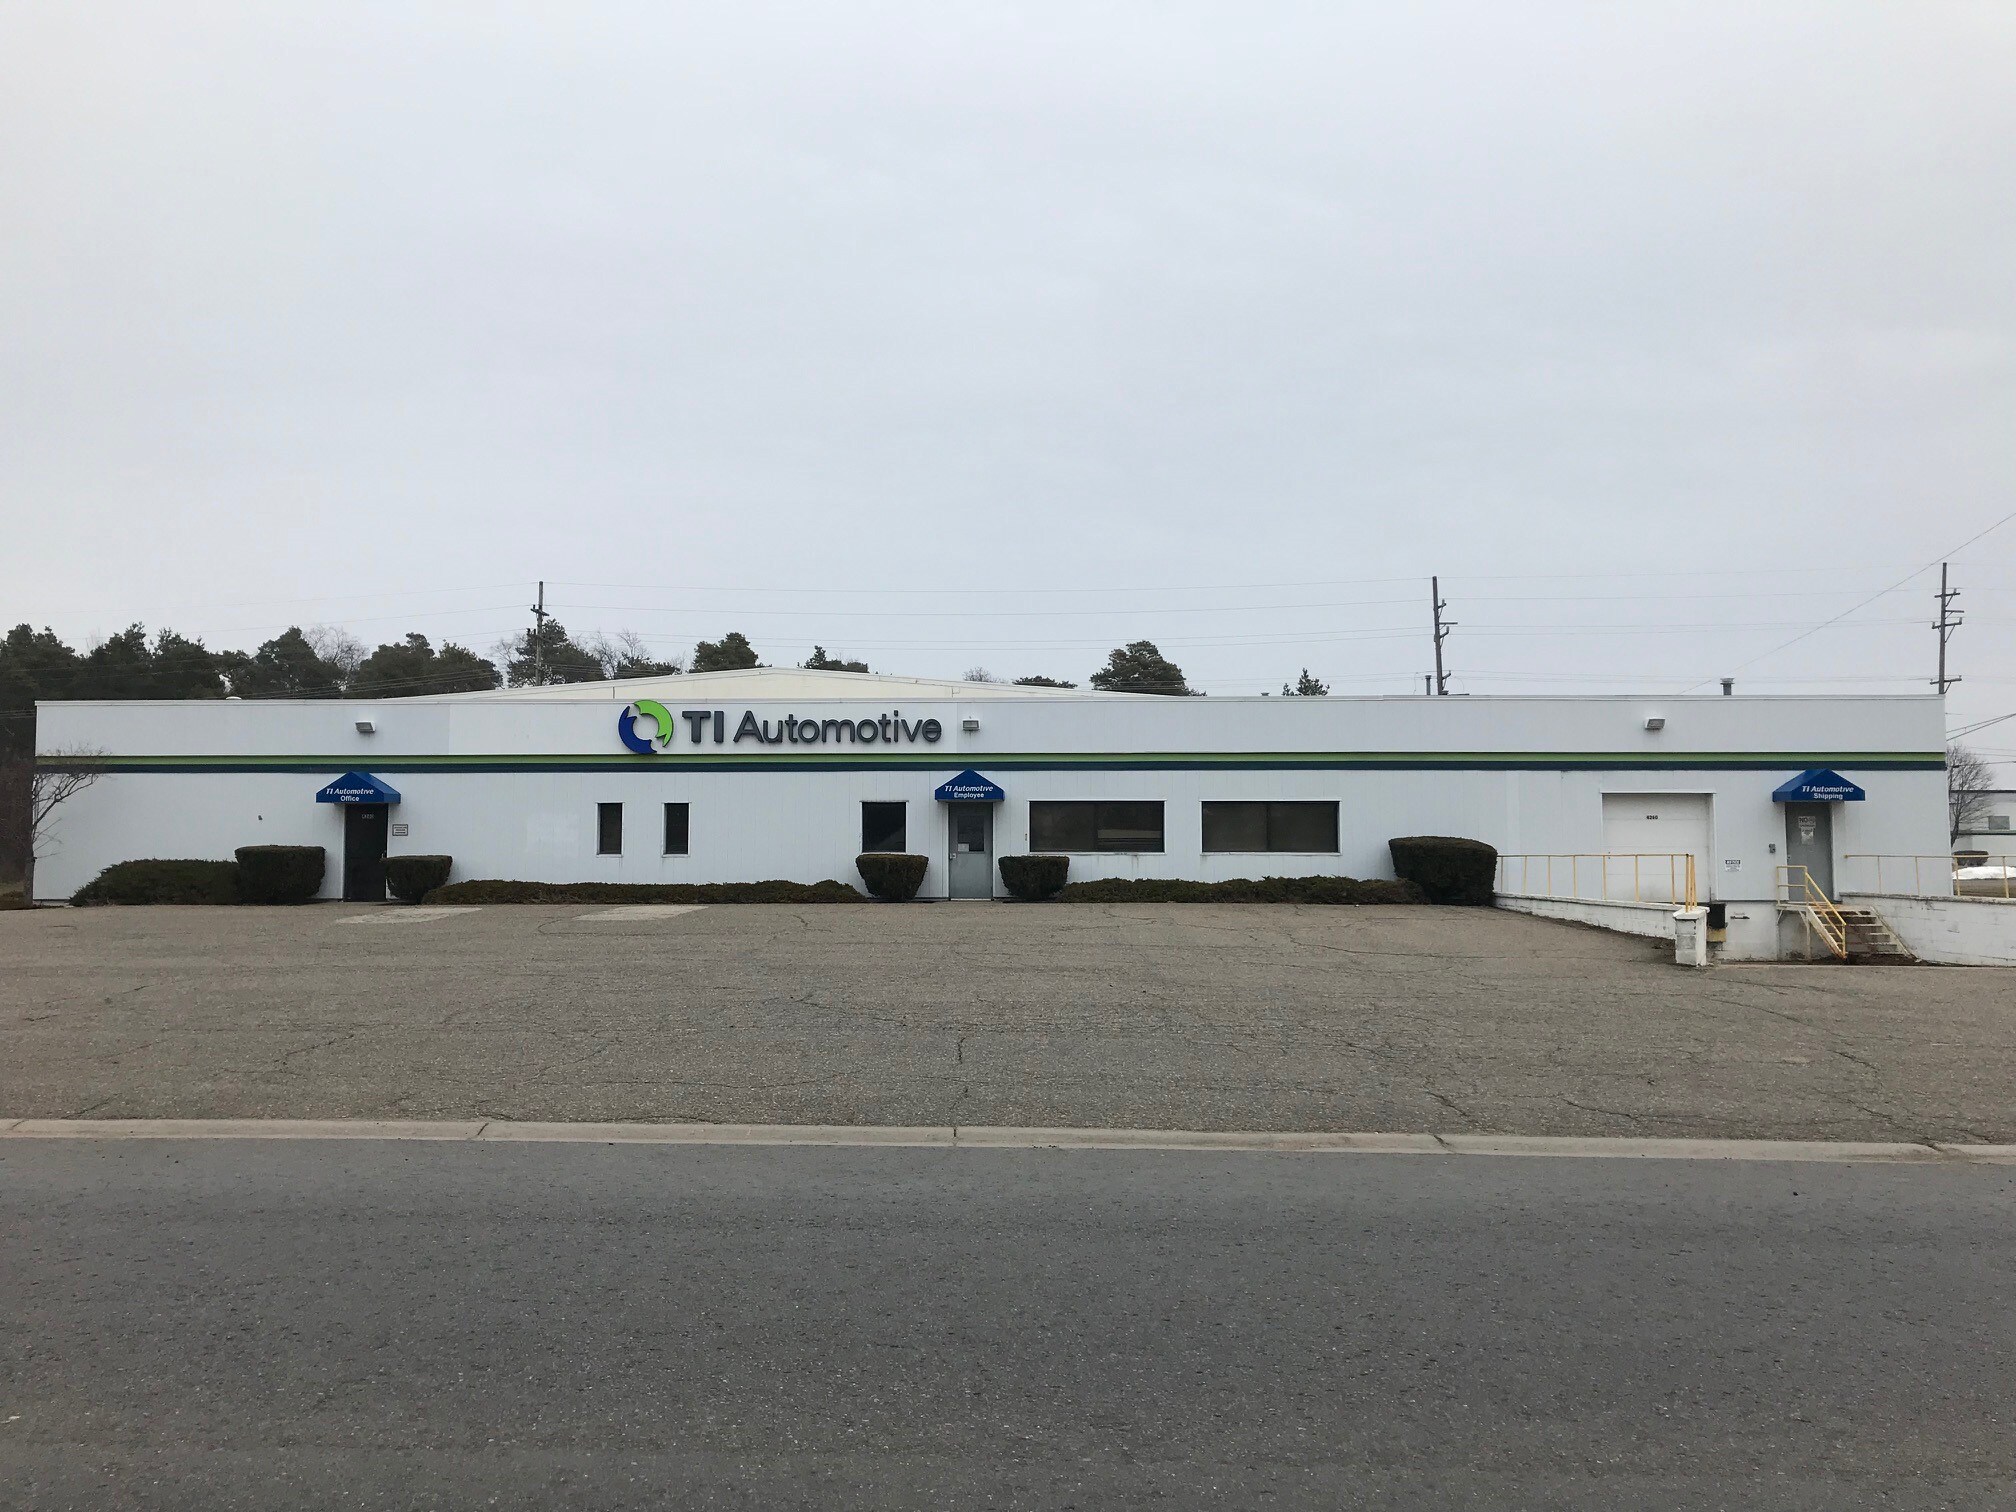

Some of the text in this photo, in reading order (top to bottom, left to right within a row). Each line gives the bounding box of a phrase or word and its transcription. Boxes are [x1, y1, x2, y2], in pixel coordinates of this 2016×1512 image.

[681, 709, 943, 744] TI Automotive
[1801, 785, 1855, 793] TI Automotive
[1813, 792, 1844, 800] Shipping
